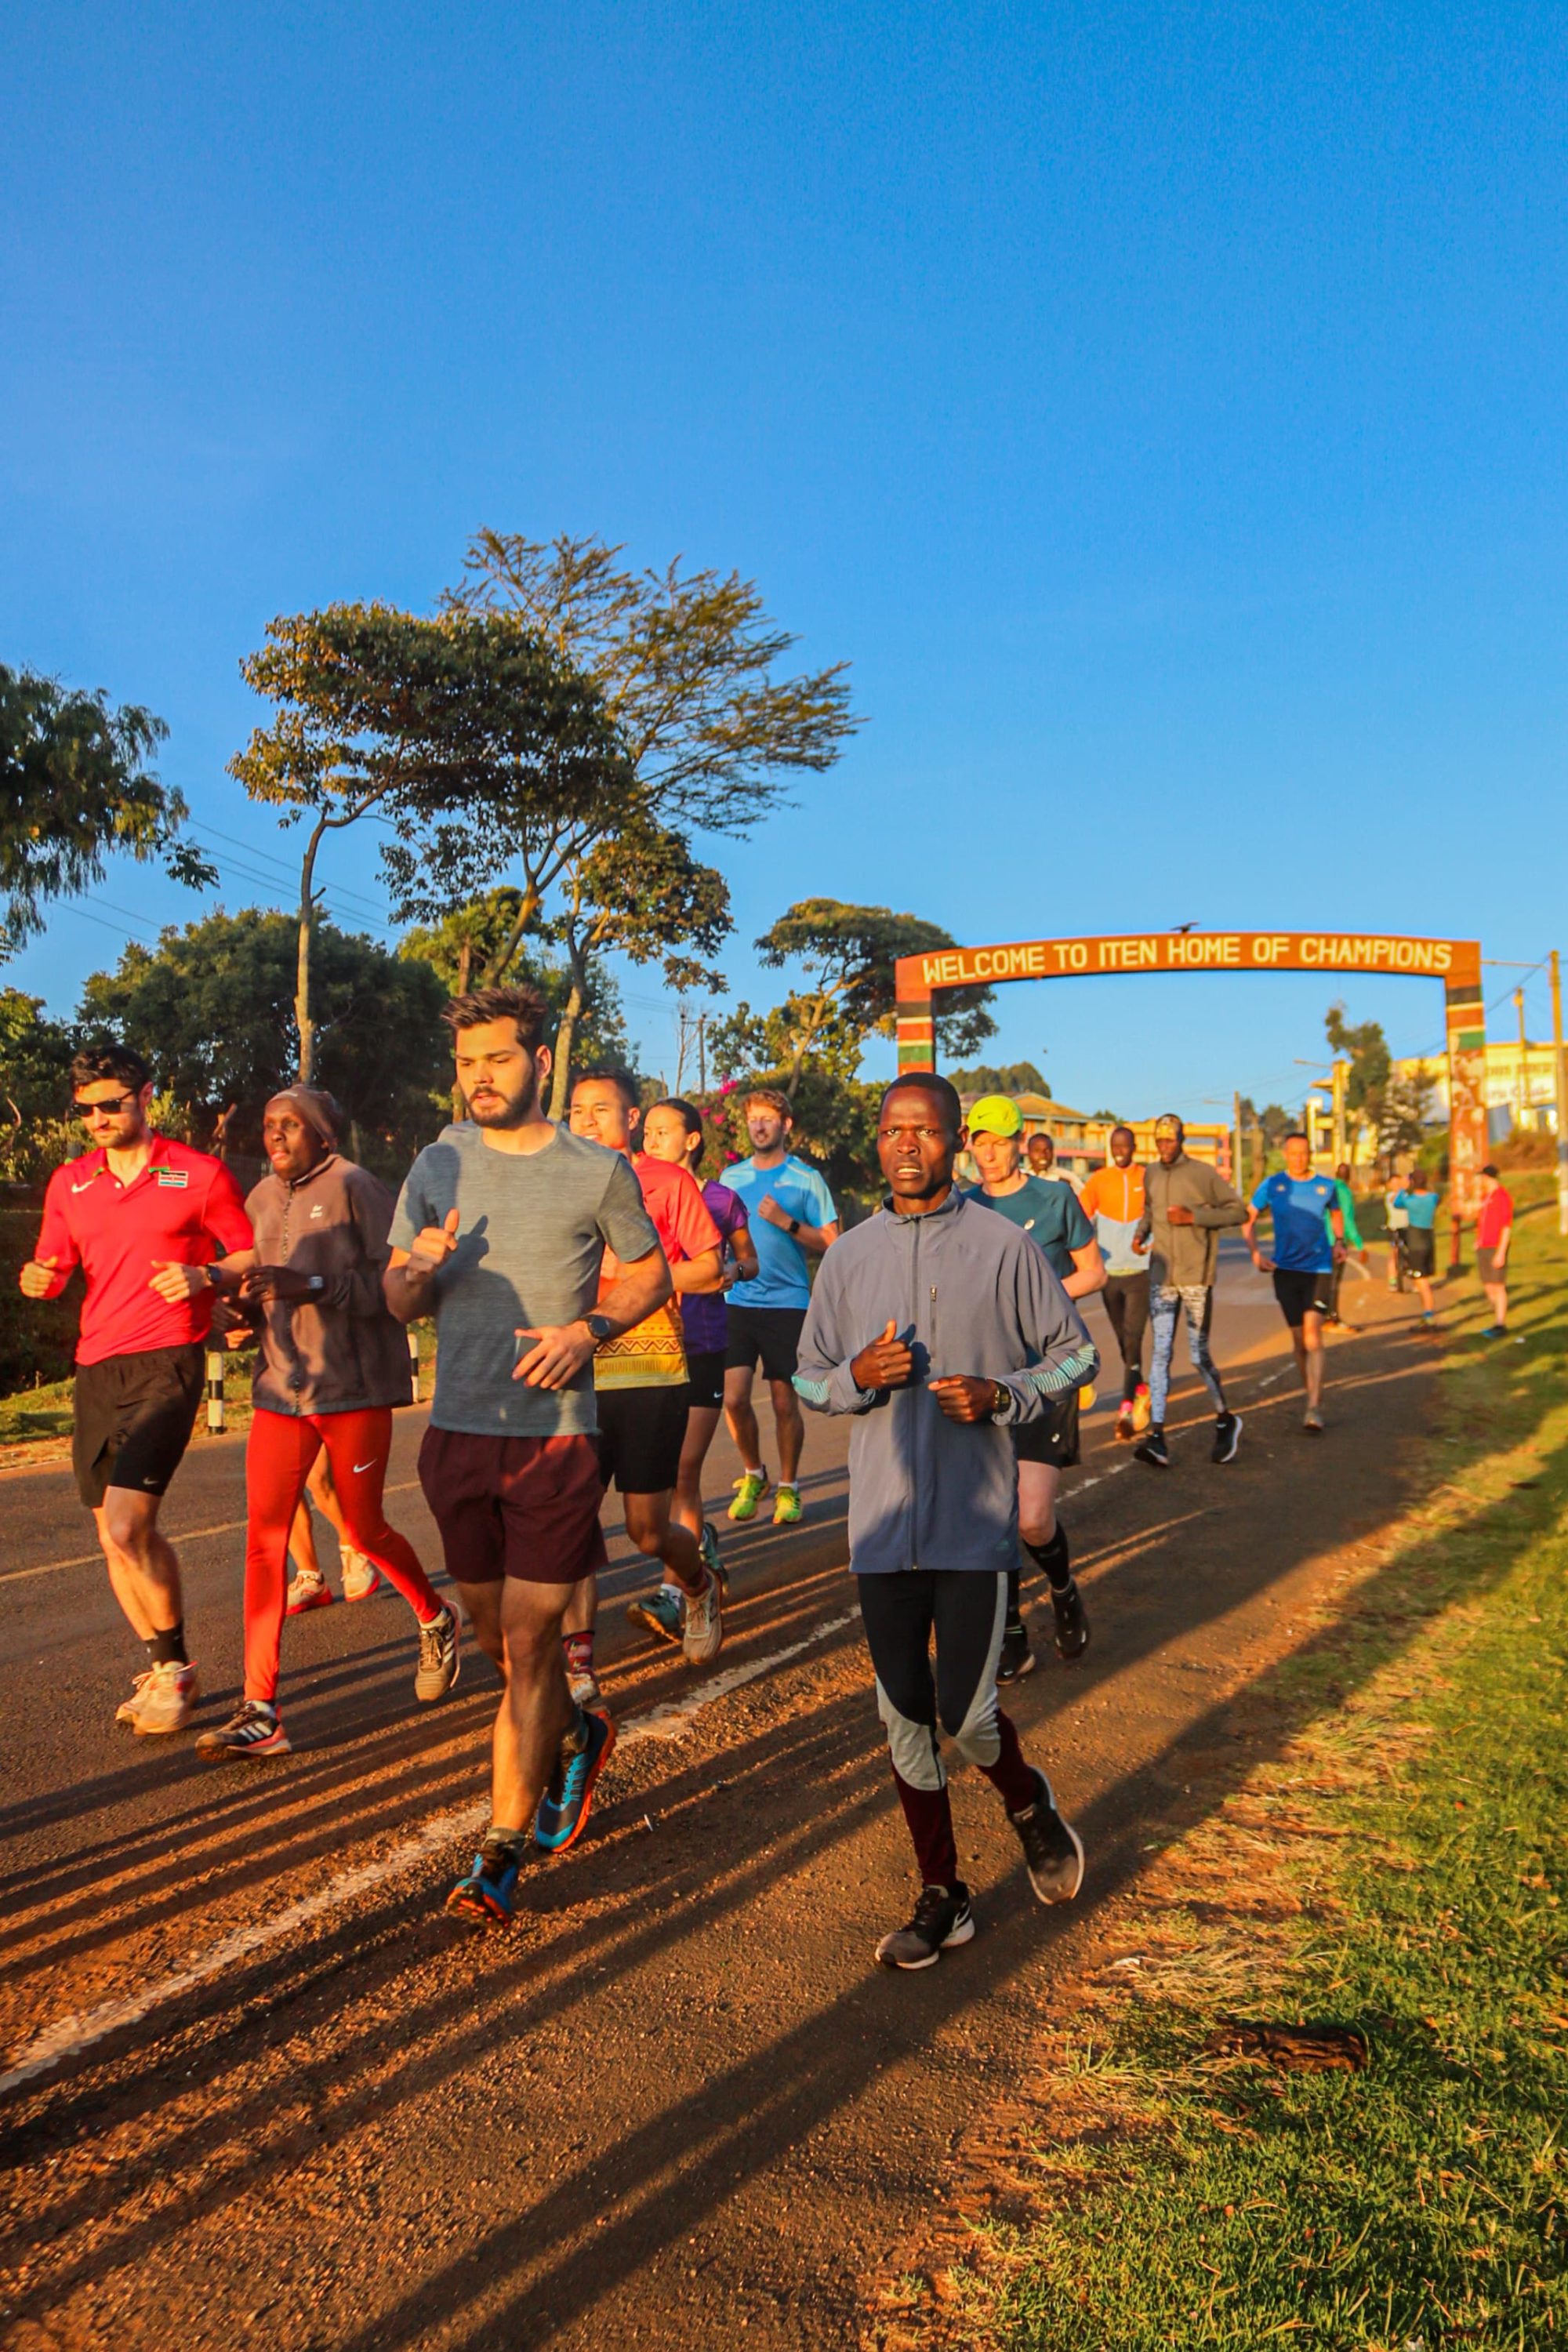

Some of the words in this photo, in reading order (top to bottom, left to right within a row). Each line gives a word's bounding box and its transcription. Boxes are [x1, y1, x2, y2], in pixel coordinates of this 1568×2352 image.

[922, 946, 1045, 984] WELCOME
[1053, 943, 1087, 969] TO
[1099, 938, 1157, 967] ITEN
[1167, 937, 1240, 964] HOME
[1252, 937, 1290, 963] OF
[1299, 938, 1453, 970] CHAMPIONS
